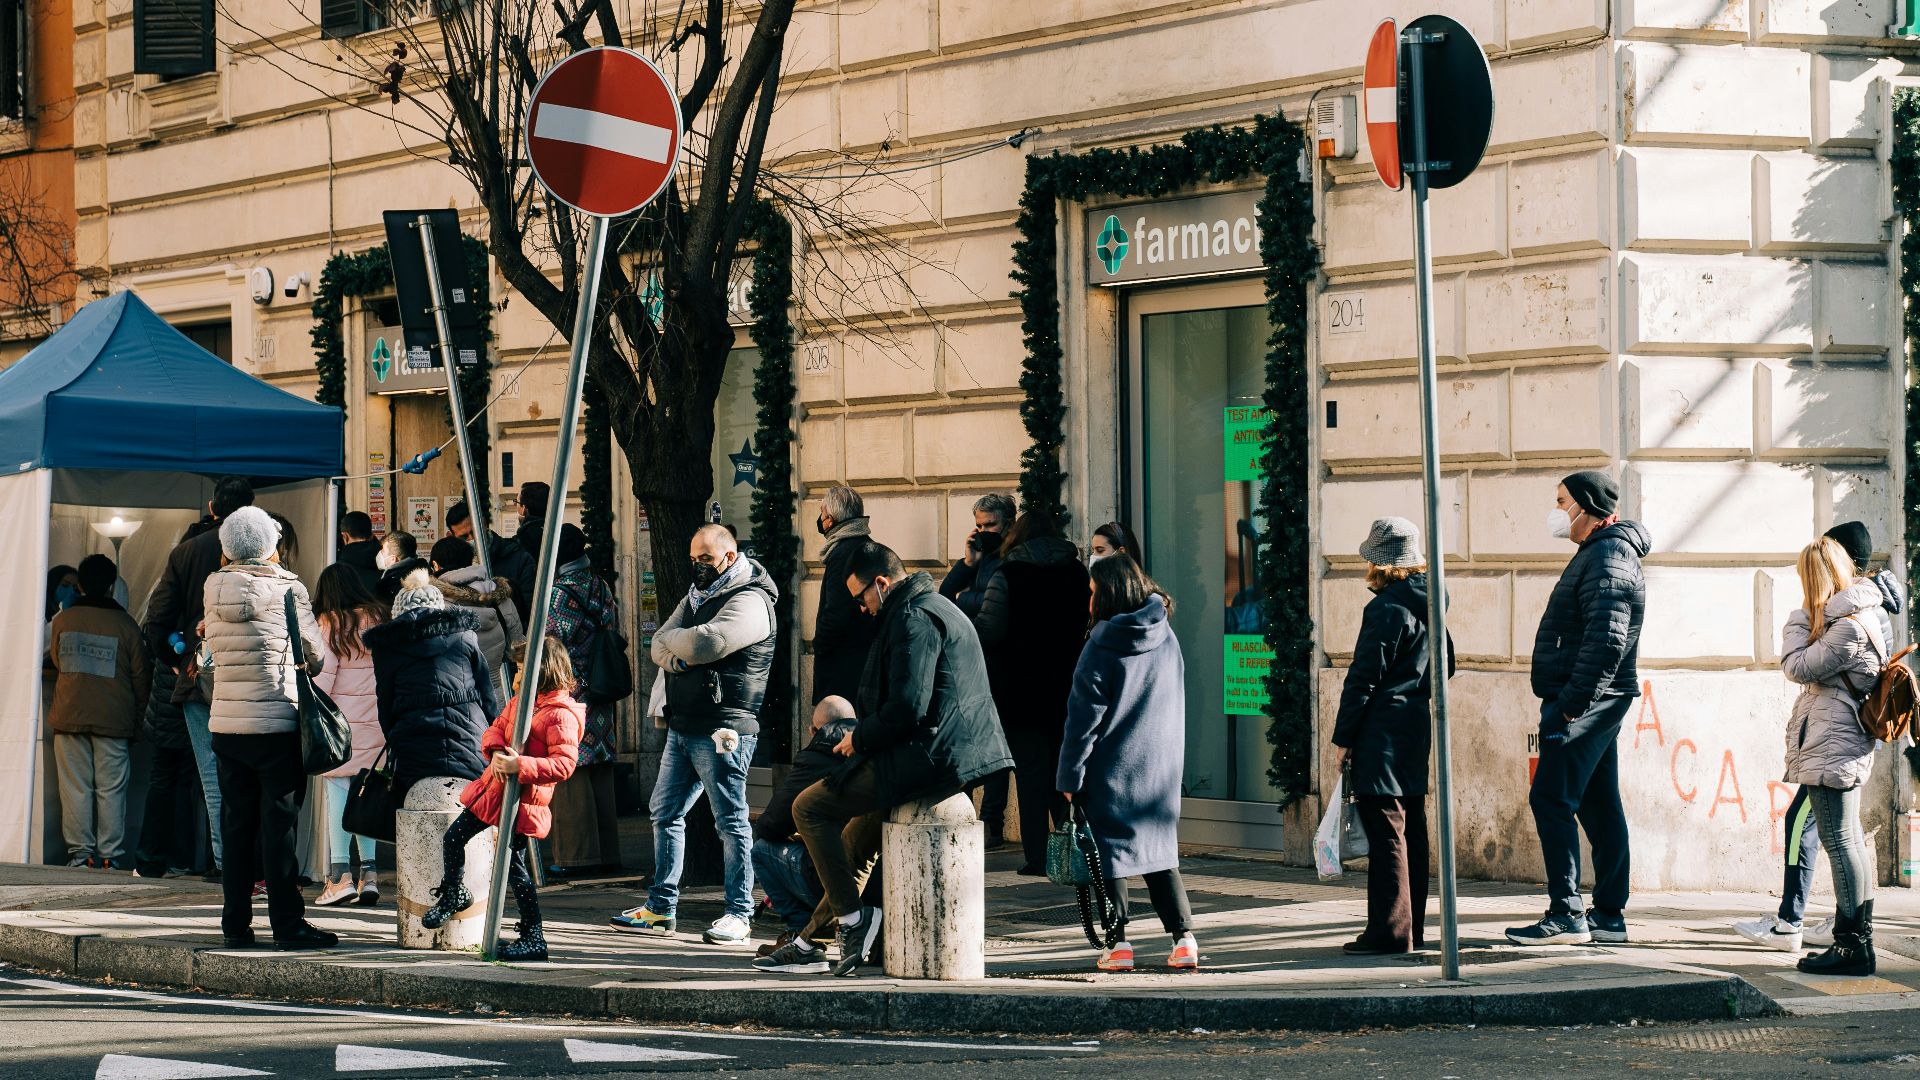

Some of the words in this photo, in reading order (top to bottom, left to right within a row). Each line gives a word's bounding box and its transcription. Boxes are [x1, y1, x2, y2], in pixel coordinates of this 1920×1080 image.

[1134, 203, 1264, 265] farmaci
[1330, 298, 1365, 327] 204
[803, 345, 829, 371] 206
[1228, 408, 1249, 422] TEST
[1249, 457, 1257, 470] A
[1246, 657, 1271, 668] REFER
